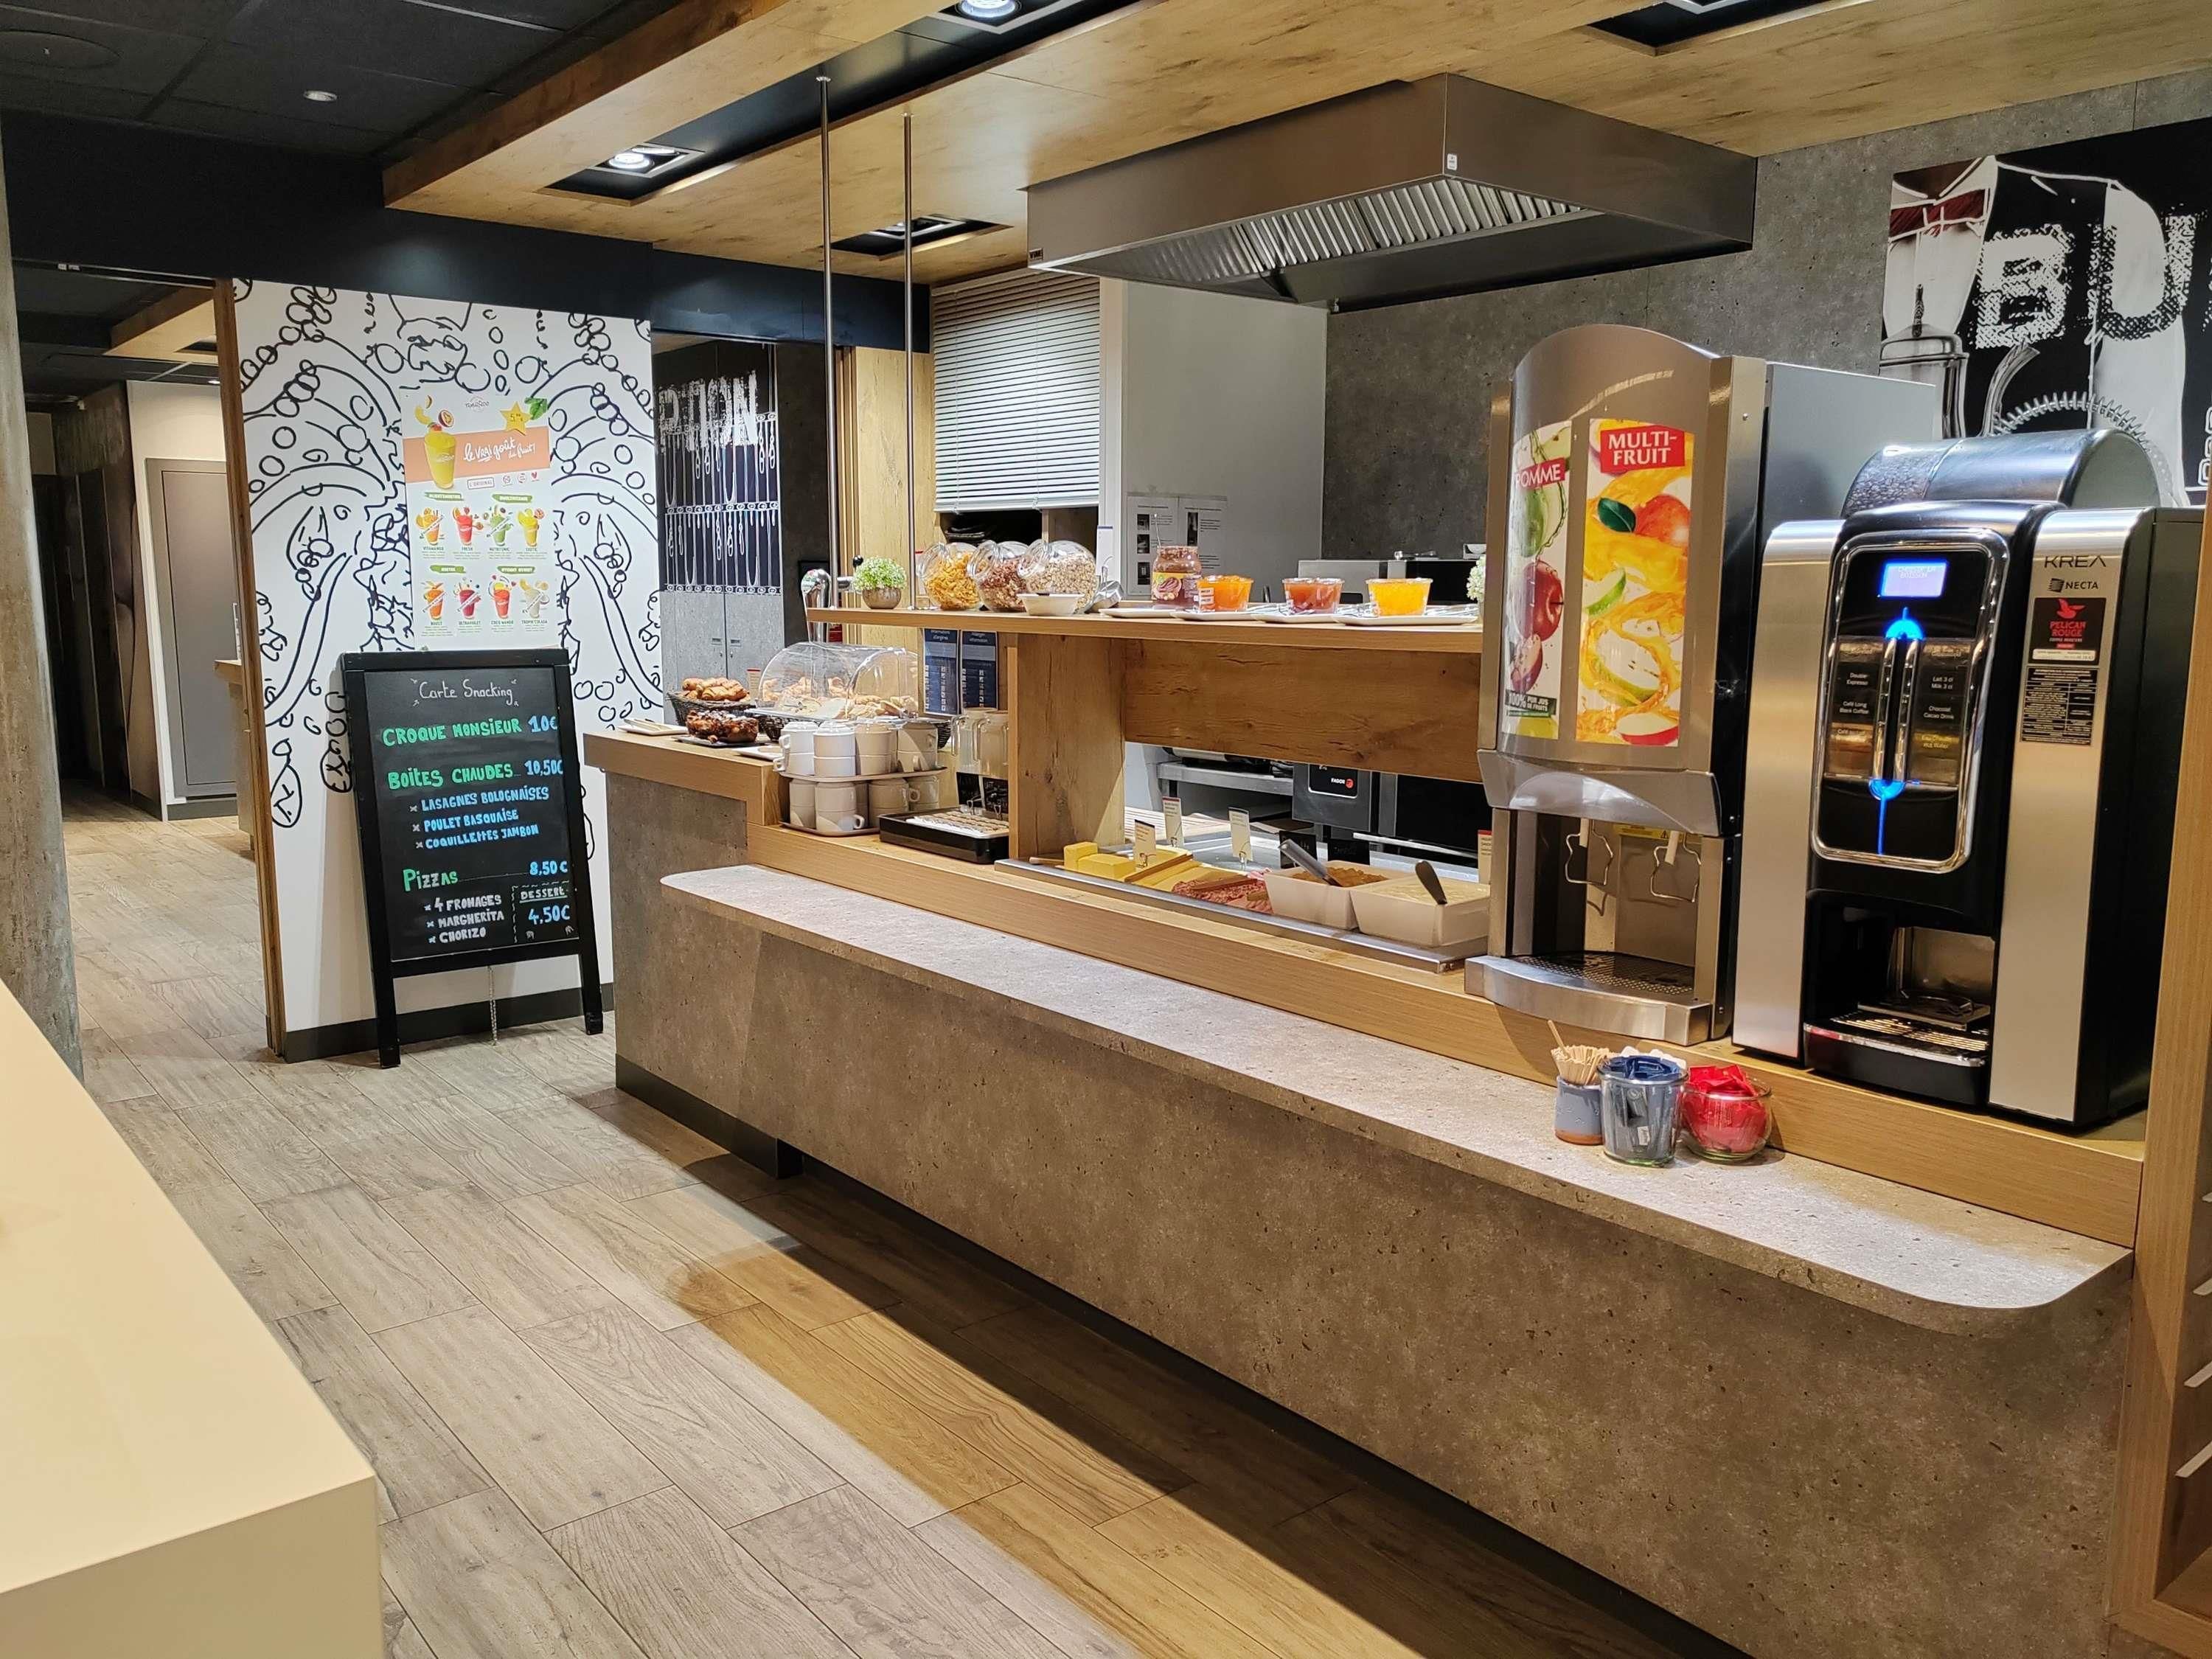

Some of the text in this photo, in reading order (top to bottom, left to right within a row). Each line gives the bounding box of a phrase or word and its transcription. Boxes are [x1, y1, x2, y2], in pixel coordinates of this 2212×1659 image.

[1608, 431, 1677, 450] MULTI-
[1613, 448, 1671, 465] FRUIT
[1516, 463, 1561, 487] POMME
[2044, 555, 2106, 568] KREA
[2065, 581, 2098, 590] NECTA
[2050, 622, 2086, 630] PELICAN
[419, 678, 513, 706] Carte Snacking
[383, 715, 558, 746] CROQUE MONSIEUR 10€
[451, 763, 513, 784] CHAUDES
[421, 785, 549, 811] LASAGNES BOLOGNAISES
[424, 807, 519, 832] POULET BASQUAISE
[425, 824, 539, 849] COQUILLETTES JAMBON
[434, 897, 443, 912] 4
[446, 894, 502, 911] FROMAGES
[438, 908, 504, 928] MARGHERITA
[439, 927, 486, 944] CHORIZO
